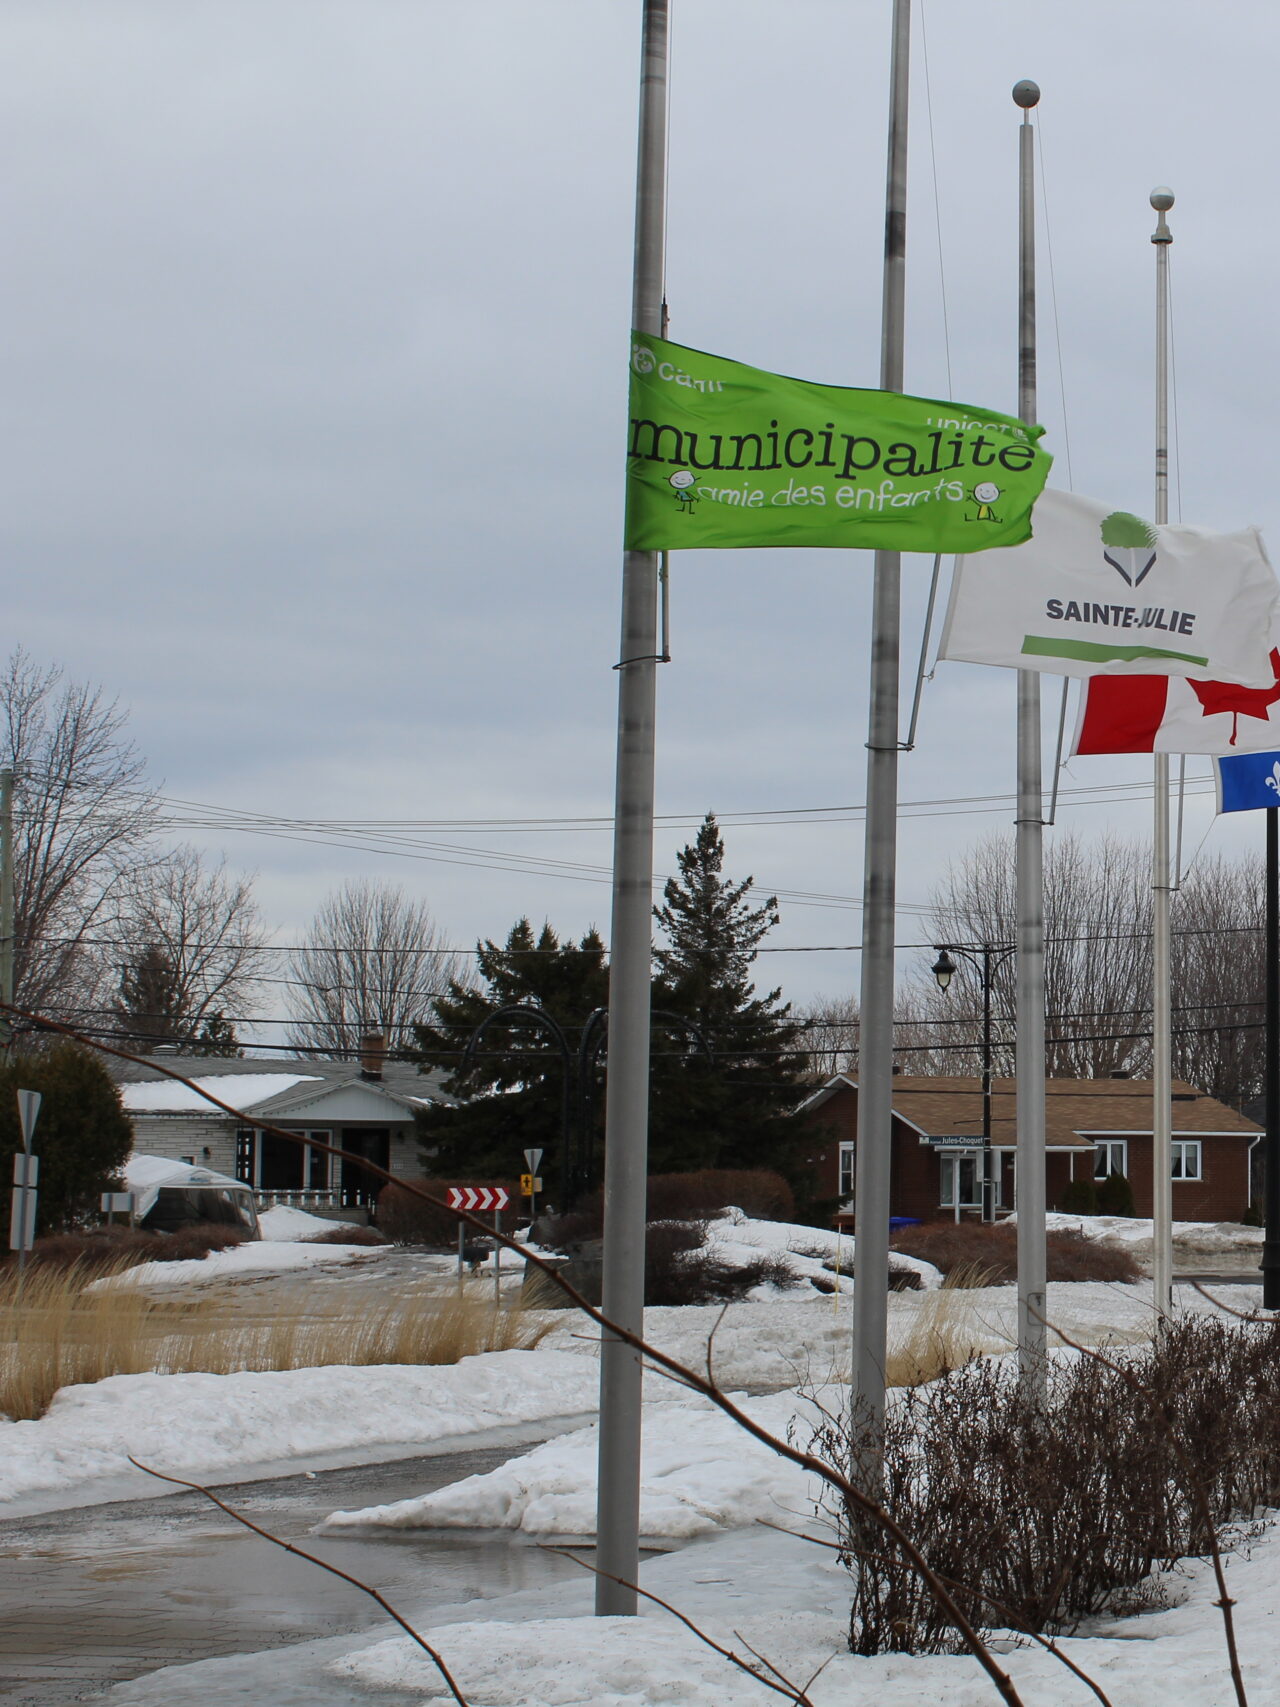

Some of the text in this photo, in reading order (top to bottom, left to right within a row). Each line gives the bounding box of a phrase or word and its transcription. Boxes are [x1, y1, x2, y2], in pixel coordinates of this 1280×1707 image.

[697, 478, 964, 512] amie des enfants
